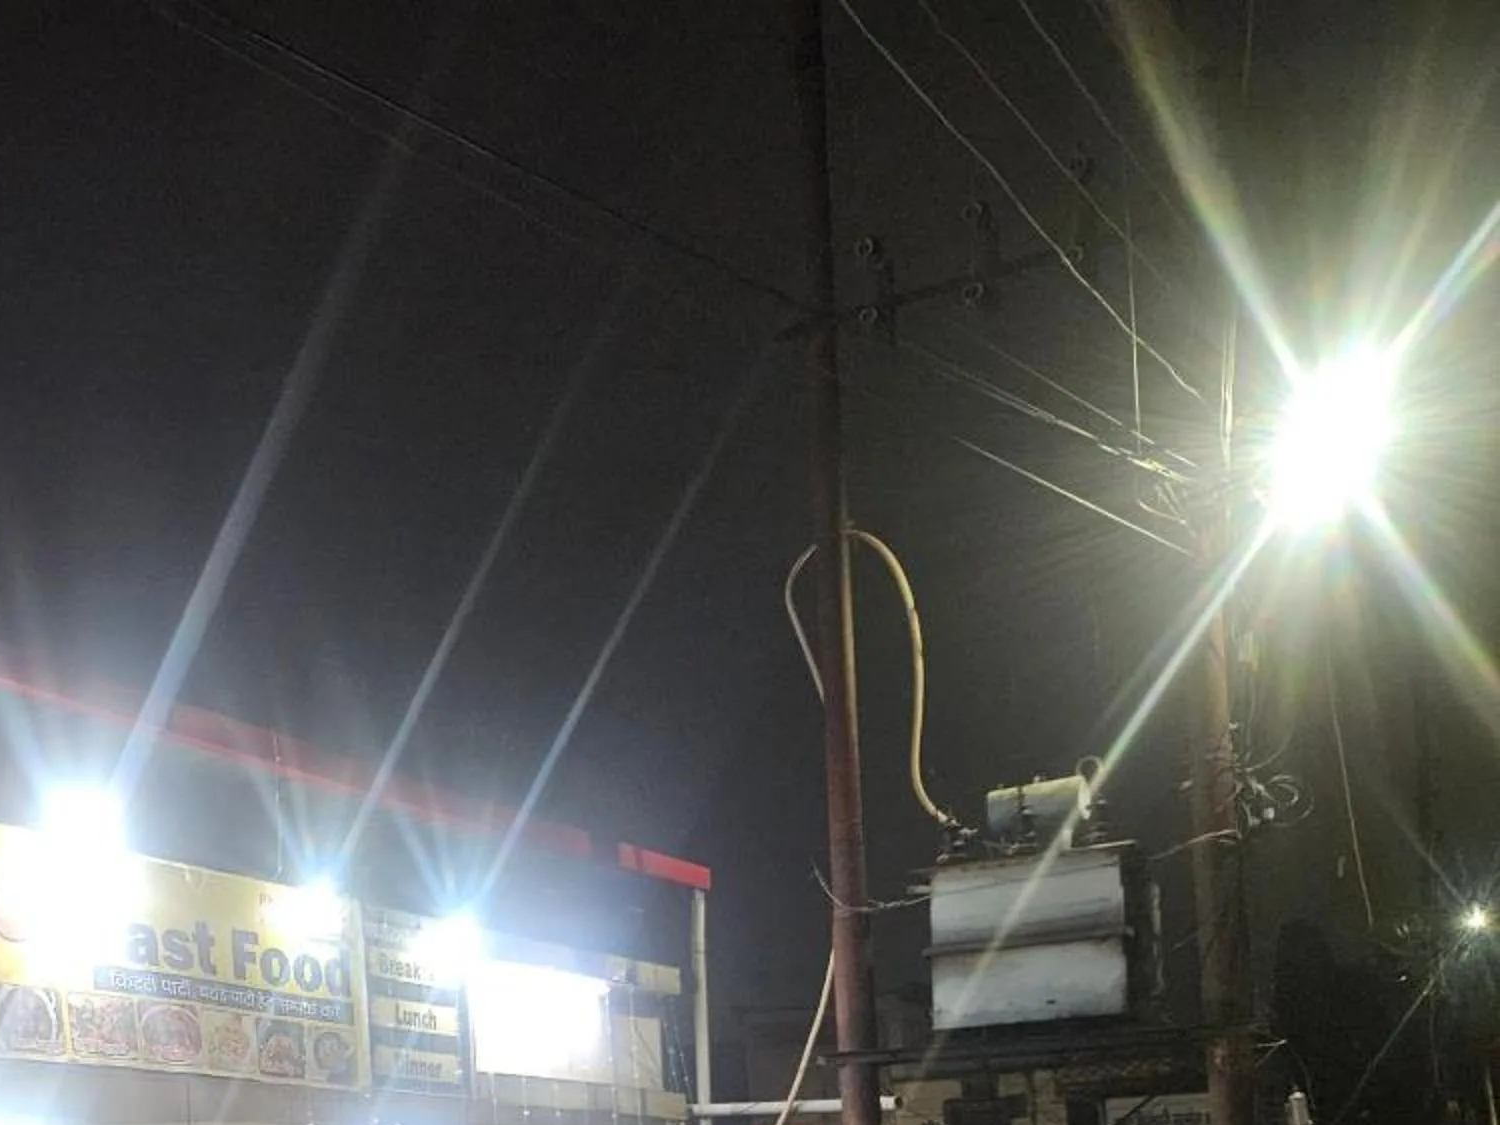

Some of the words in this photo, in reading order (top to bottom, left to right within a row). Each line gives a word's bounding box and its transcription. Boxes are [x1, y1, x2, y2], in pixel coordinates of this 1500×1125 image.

[129, 921, 216, 977] ast
[230, 927, 352, 998] Food
[394, 1000, 438, 1031] Lunch
